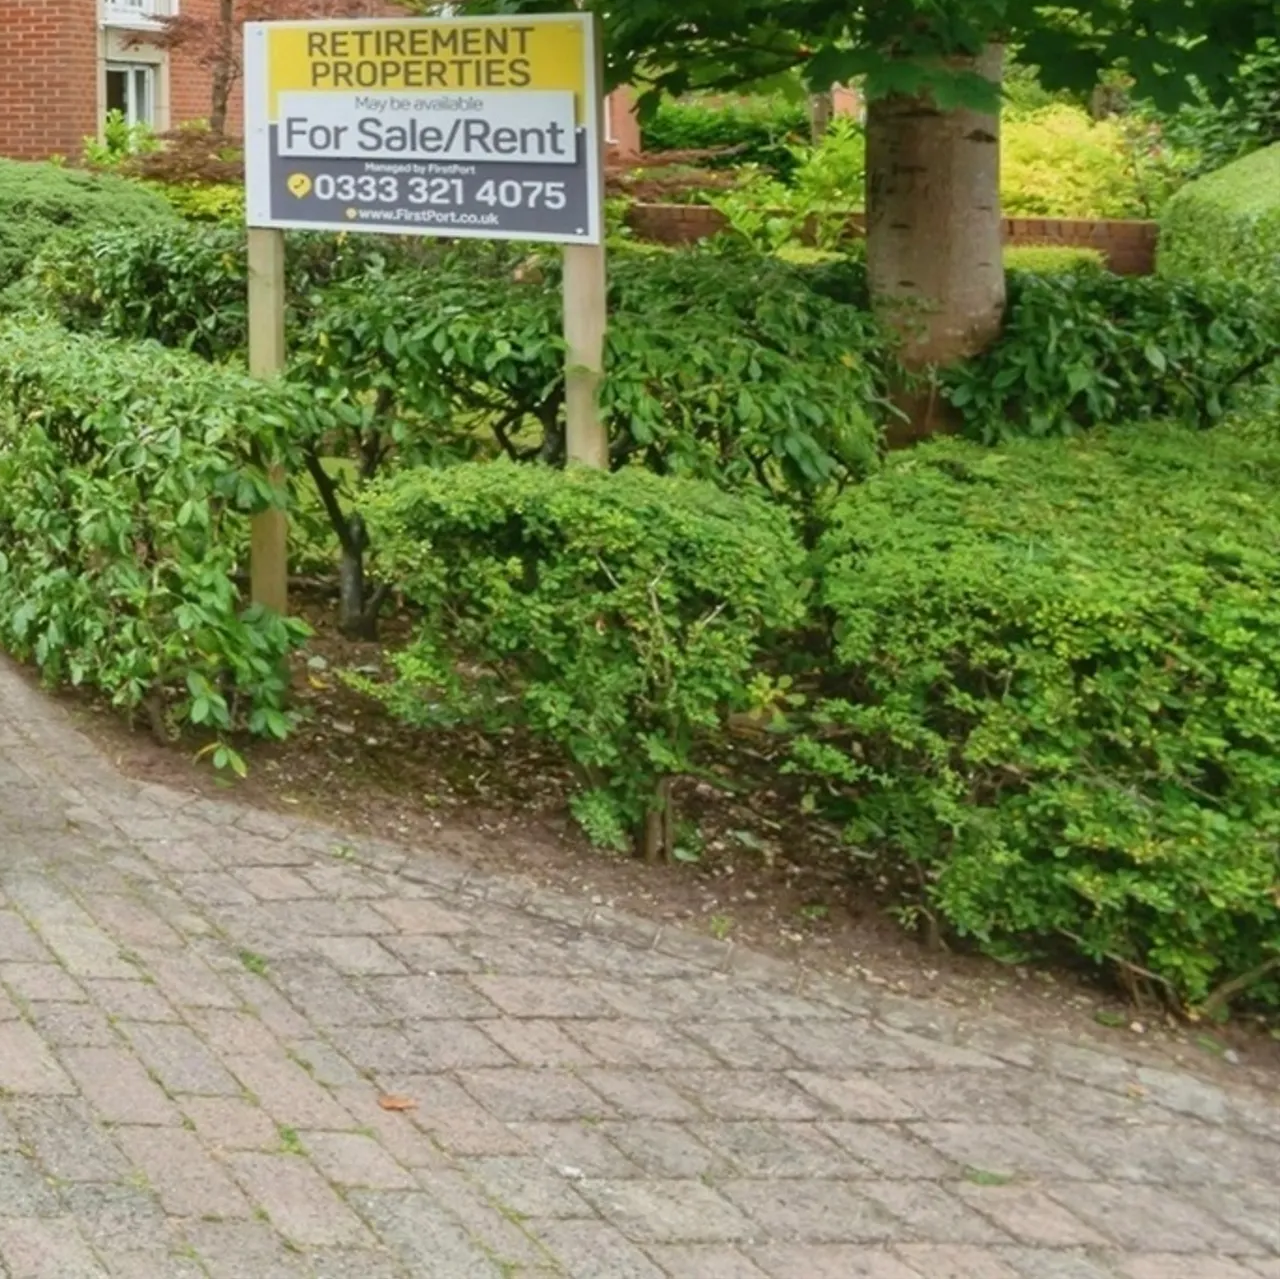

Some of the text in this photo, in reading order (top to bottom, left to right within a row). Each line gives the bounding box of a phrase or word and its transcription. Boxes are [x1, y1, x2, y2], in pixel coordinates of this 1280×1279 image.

[307, 27, 534, 58] RETIREMENT
[311, 59, 531, 88] PROPERTIES
[355, 96, 484, 113] May be available
[286, 118, 566, 155] For Sale/Rent
[364, 162, 476, 175] Managed by FirstPort
[314, 174, 566, 209] 0333 321 4075
[359, 208, 499, 225] www.FirstPort.co.uk
